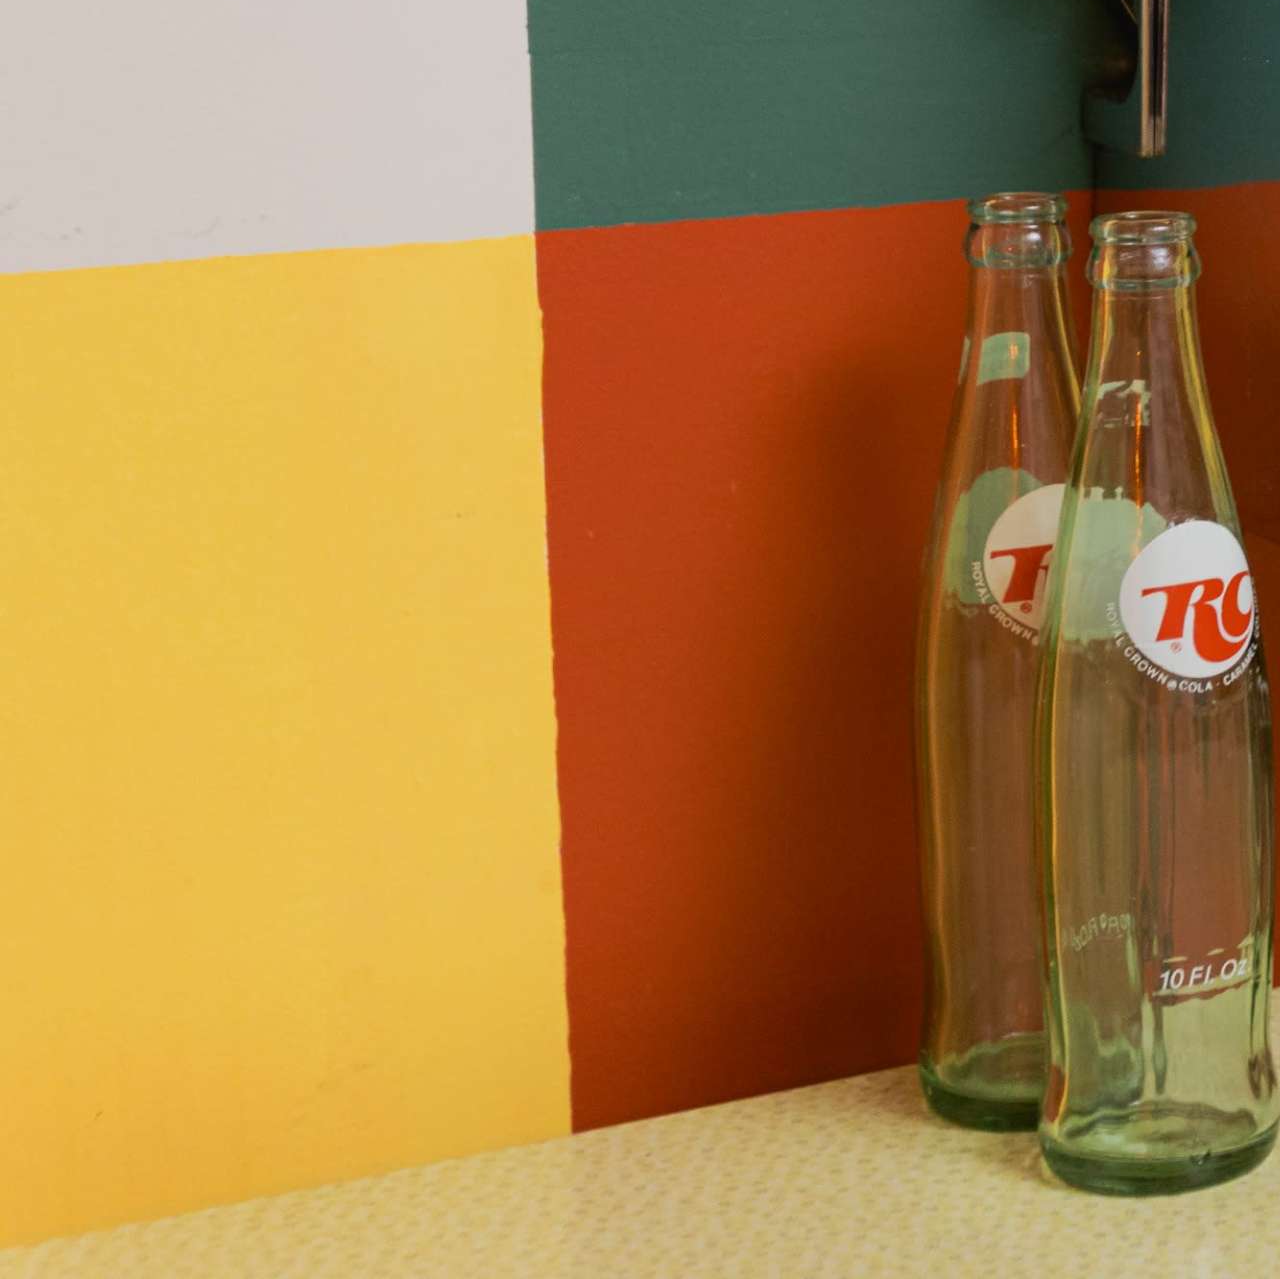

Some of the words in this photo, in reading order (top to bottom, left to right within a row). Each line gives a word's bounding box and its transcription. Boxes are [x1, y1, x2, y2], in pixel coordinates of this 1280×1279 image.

[971, 560, 991, 605] ROYAL
[1141, 569, 1255, 663] RC
[1178, 678, 1214, 694] COLA
[1160, 968, 1184, 991] 10
